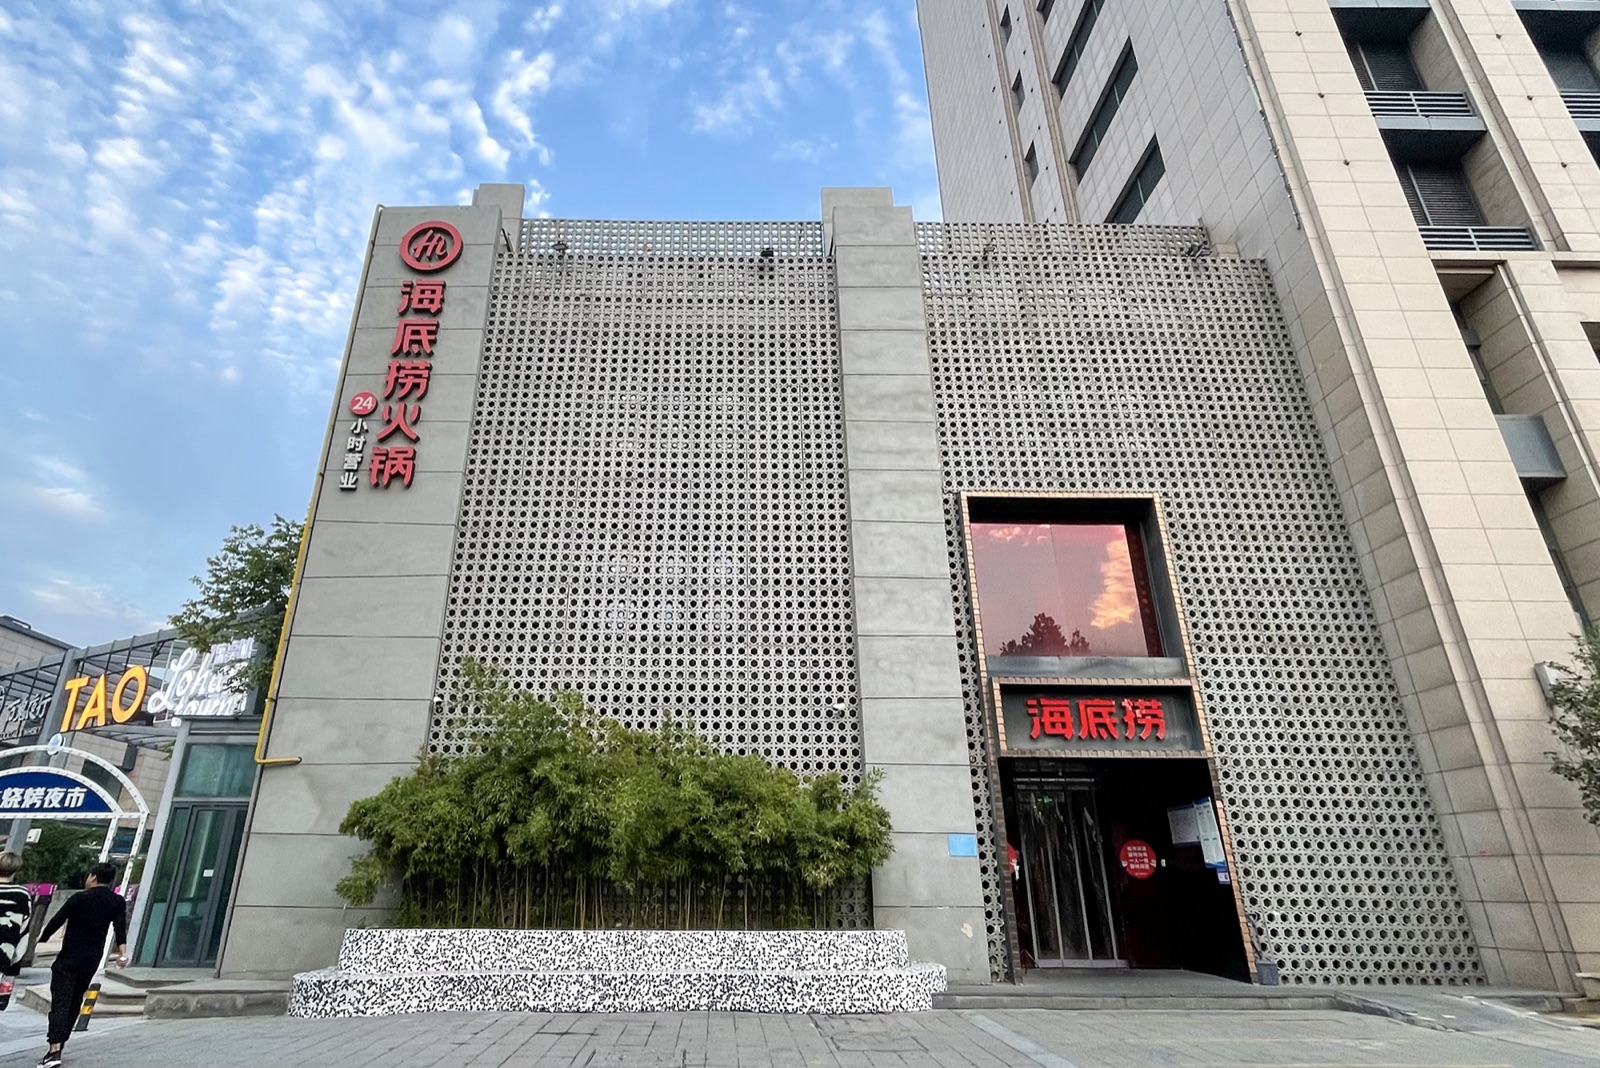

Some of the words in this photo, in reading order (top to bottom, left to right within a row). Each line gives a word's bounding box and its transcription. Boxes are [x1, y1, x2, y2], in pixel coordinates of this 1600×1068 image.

[370, 279, 445, 486] 海底捞火锅
[60, 665, 147, 733] TAO
[1027, 697, 1166, 740] 海底捞
[0, 787, 87, 809] 烧烤夜市
